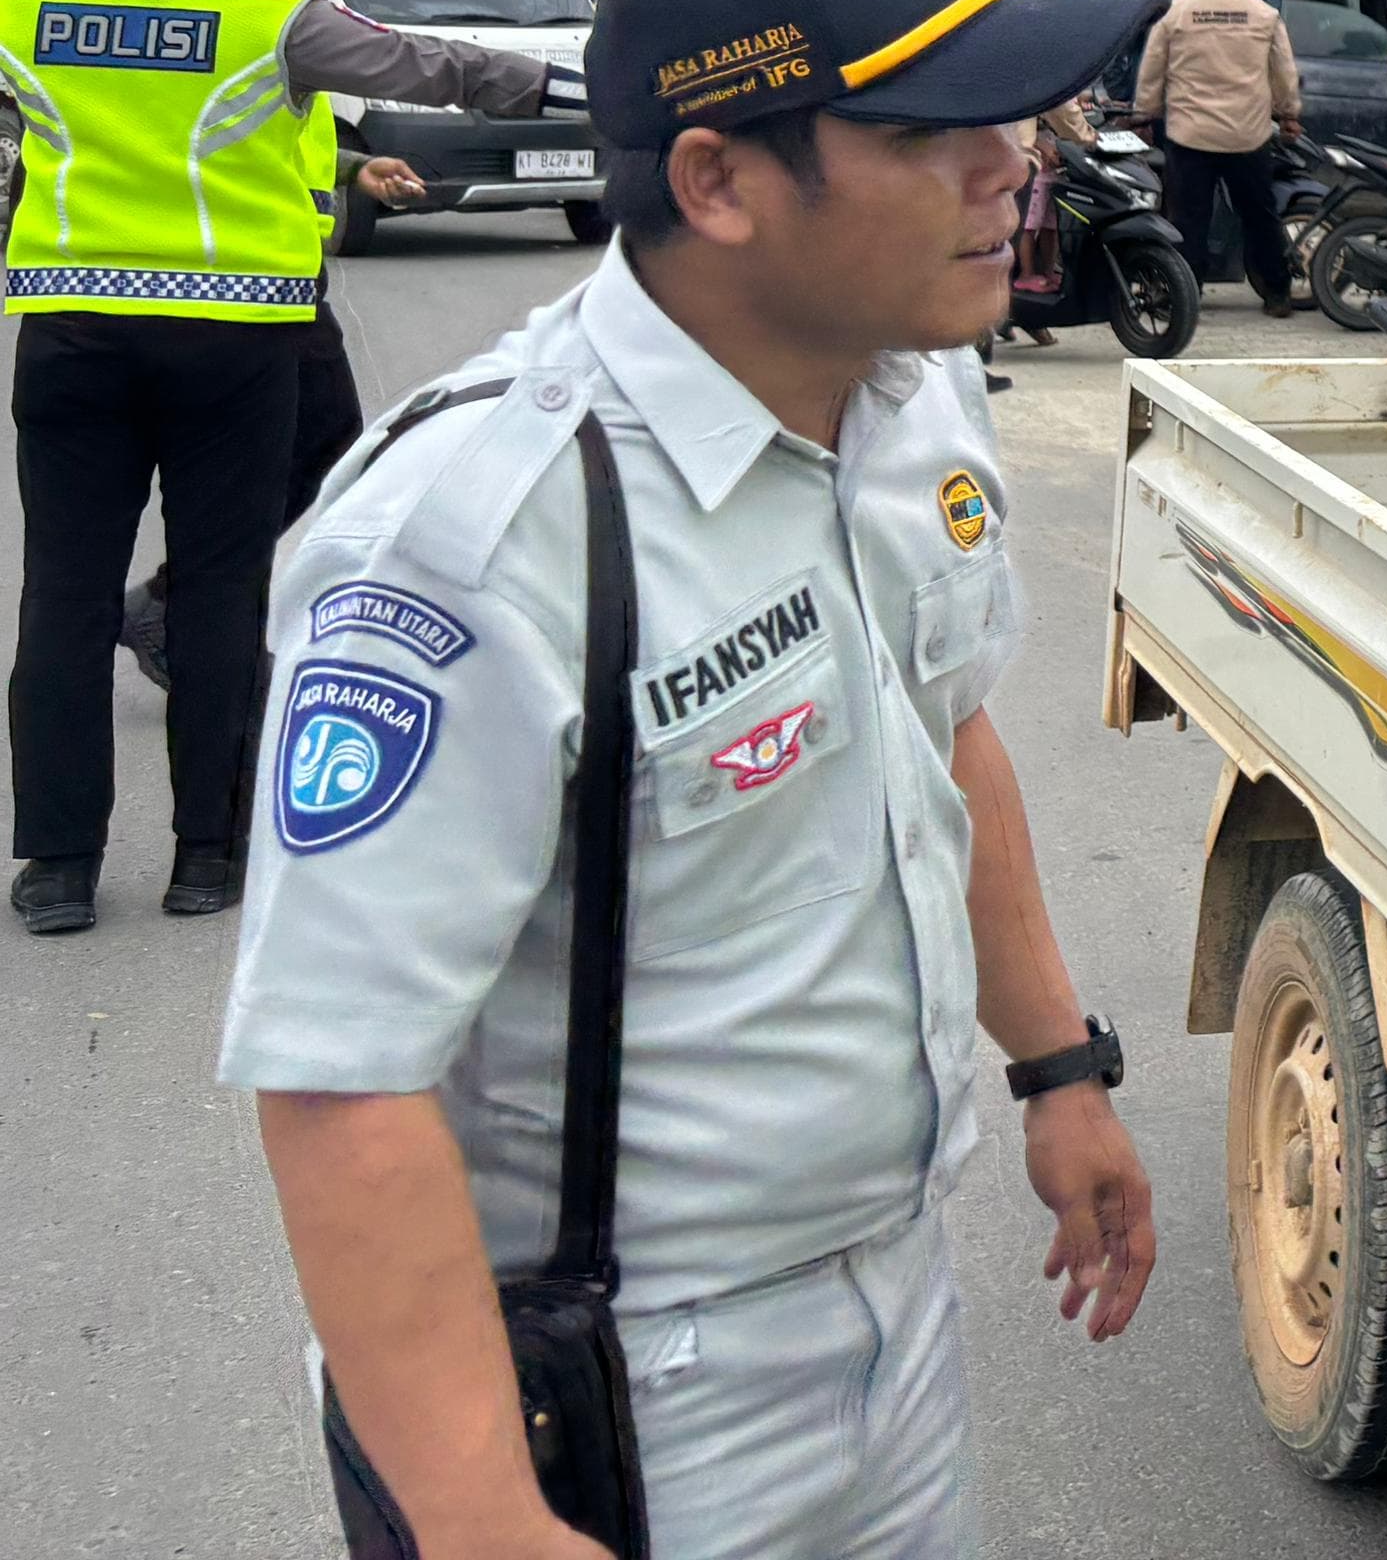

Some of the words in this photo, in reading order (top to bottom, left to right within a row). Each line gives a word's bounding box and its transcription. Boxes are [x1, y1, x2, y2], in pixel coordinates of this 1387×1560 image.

[40, 13, 211, 62] POLISI
[657, 57, 701, 94] JASA
[702, 23, 804, 72] RAHARJA
[519, 153, 531, 168] KT
[398, 608, 450, 653] UTARA
[646, 587, 819, 727] IFANSYAH
[324, 682, 417, 734] RAHARJA
